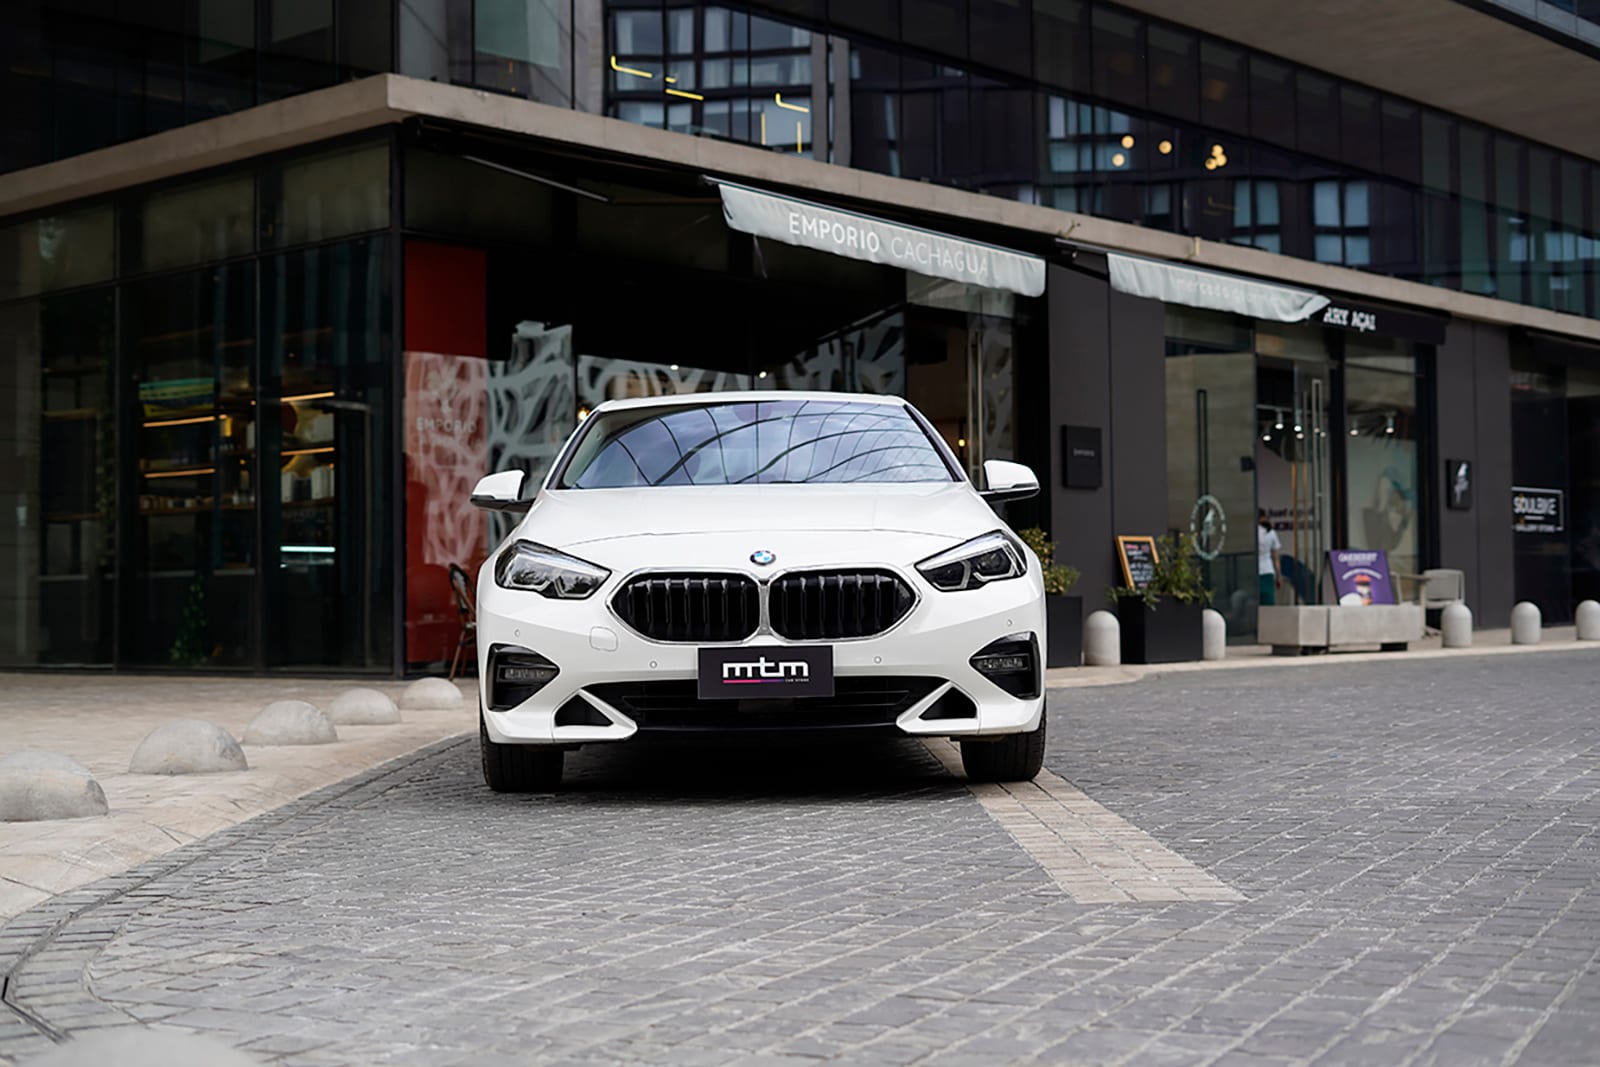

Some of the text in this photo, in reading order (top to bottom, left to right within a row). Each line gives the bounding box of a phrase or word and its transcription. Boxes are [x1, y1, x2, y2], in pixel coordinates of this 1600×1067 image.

[788, 212, 989, 276] EMPORIO CACHAGUA
[722, 656, 809, 678] mtm
